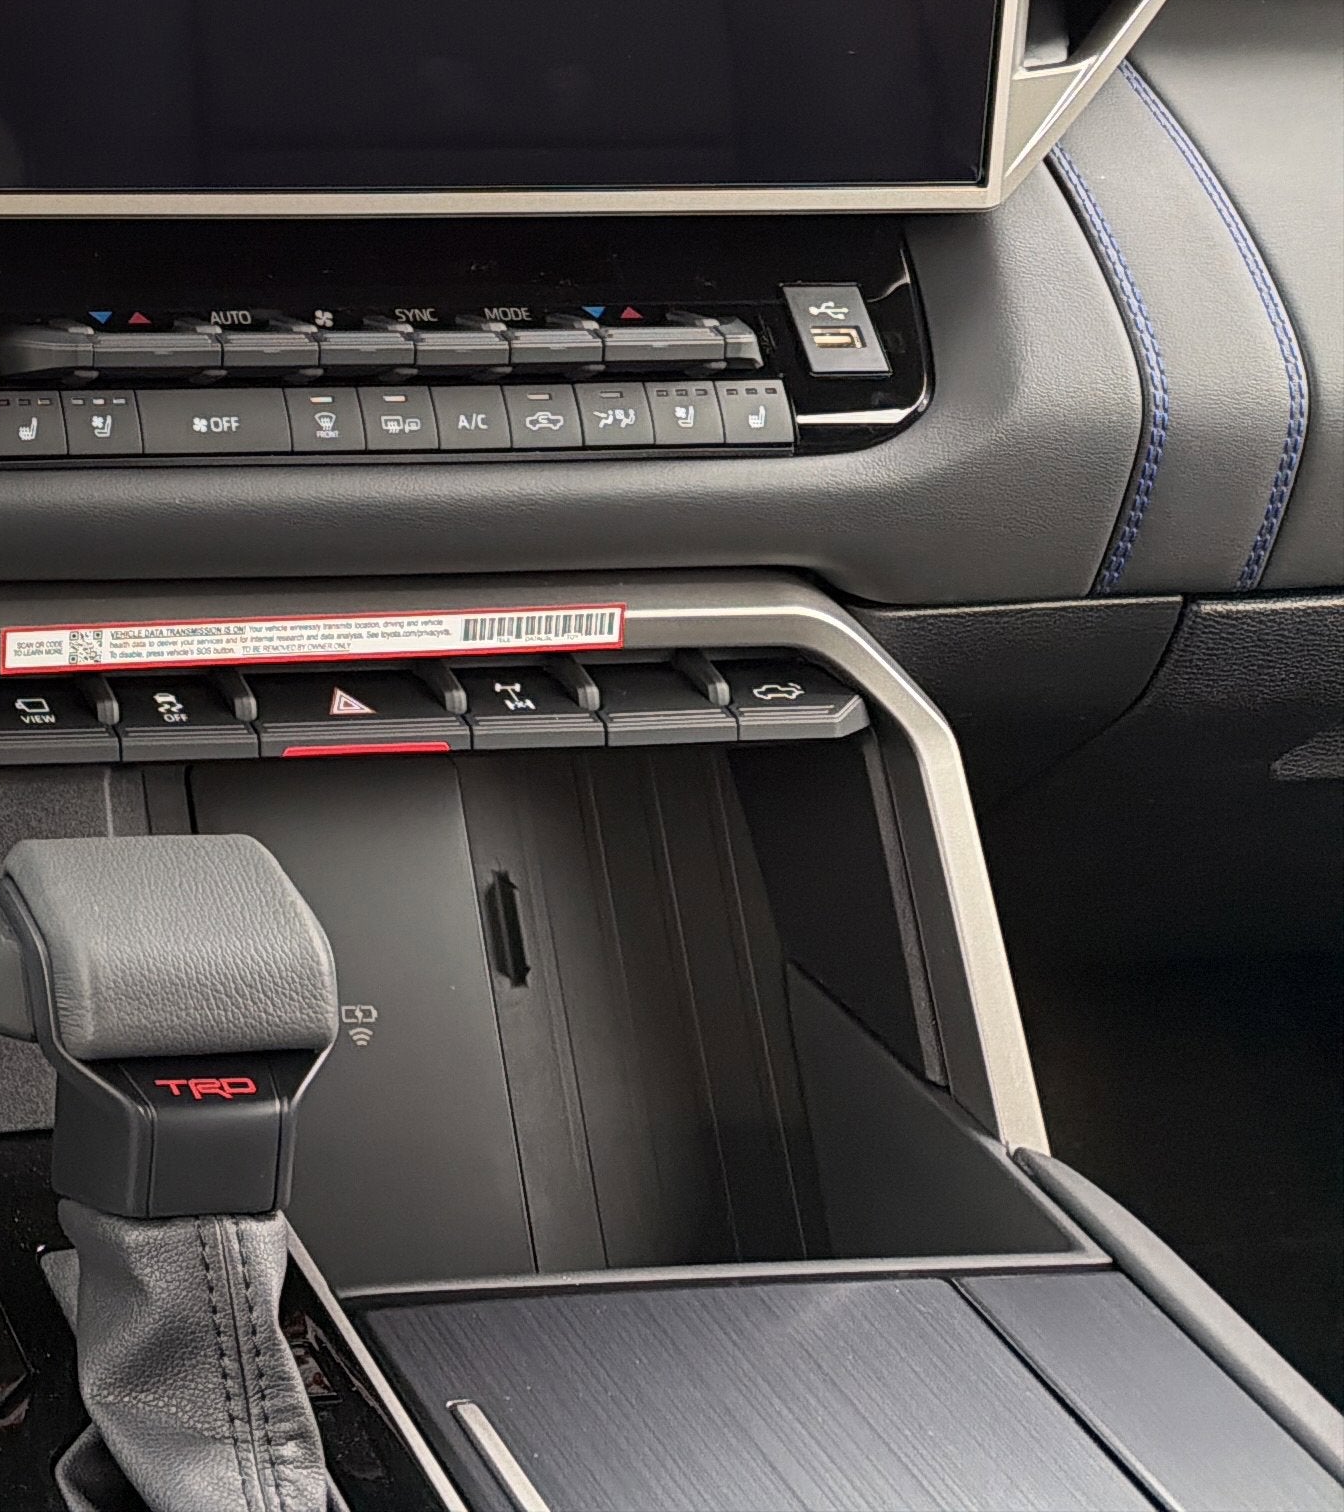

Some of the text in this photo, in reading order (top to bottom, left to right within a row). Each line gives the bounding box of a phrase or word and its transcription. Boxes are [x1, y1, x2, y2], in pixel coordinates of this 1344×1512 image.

[210, 311, 252, 326] AUTO
[394, 308, 436, 323] SYNC
[484, 307, 532, 323] MODE
[210, 417, 240, 431] OFF
[457, 414, 489, 431] A/C
[316, 430, 339, 439] FRONT
[110, 630, 143, 639] VEHICLE
[145, 629, 164, 638] DATA
[166, 626, 221, 637] TRANSMISSION
[17, 640, 33, 649] SCAN
[46, 640, 63, 648] CODE
[196, 647, 211, 655] SOS
[23, 649, 44, 657] LEARN
[45, 648, 63, 656] MORE
[20, 715, 56, 724] VIEW
[163, 714, 189, 723] OFF
[154, 1077, 257, 1101] TRD
